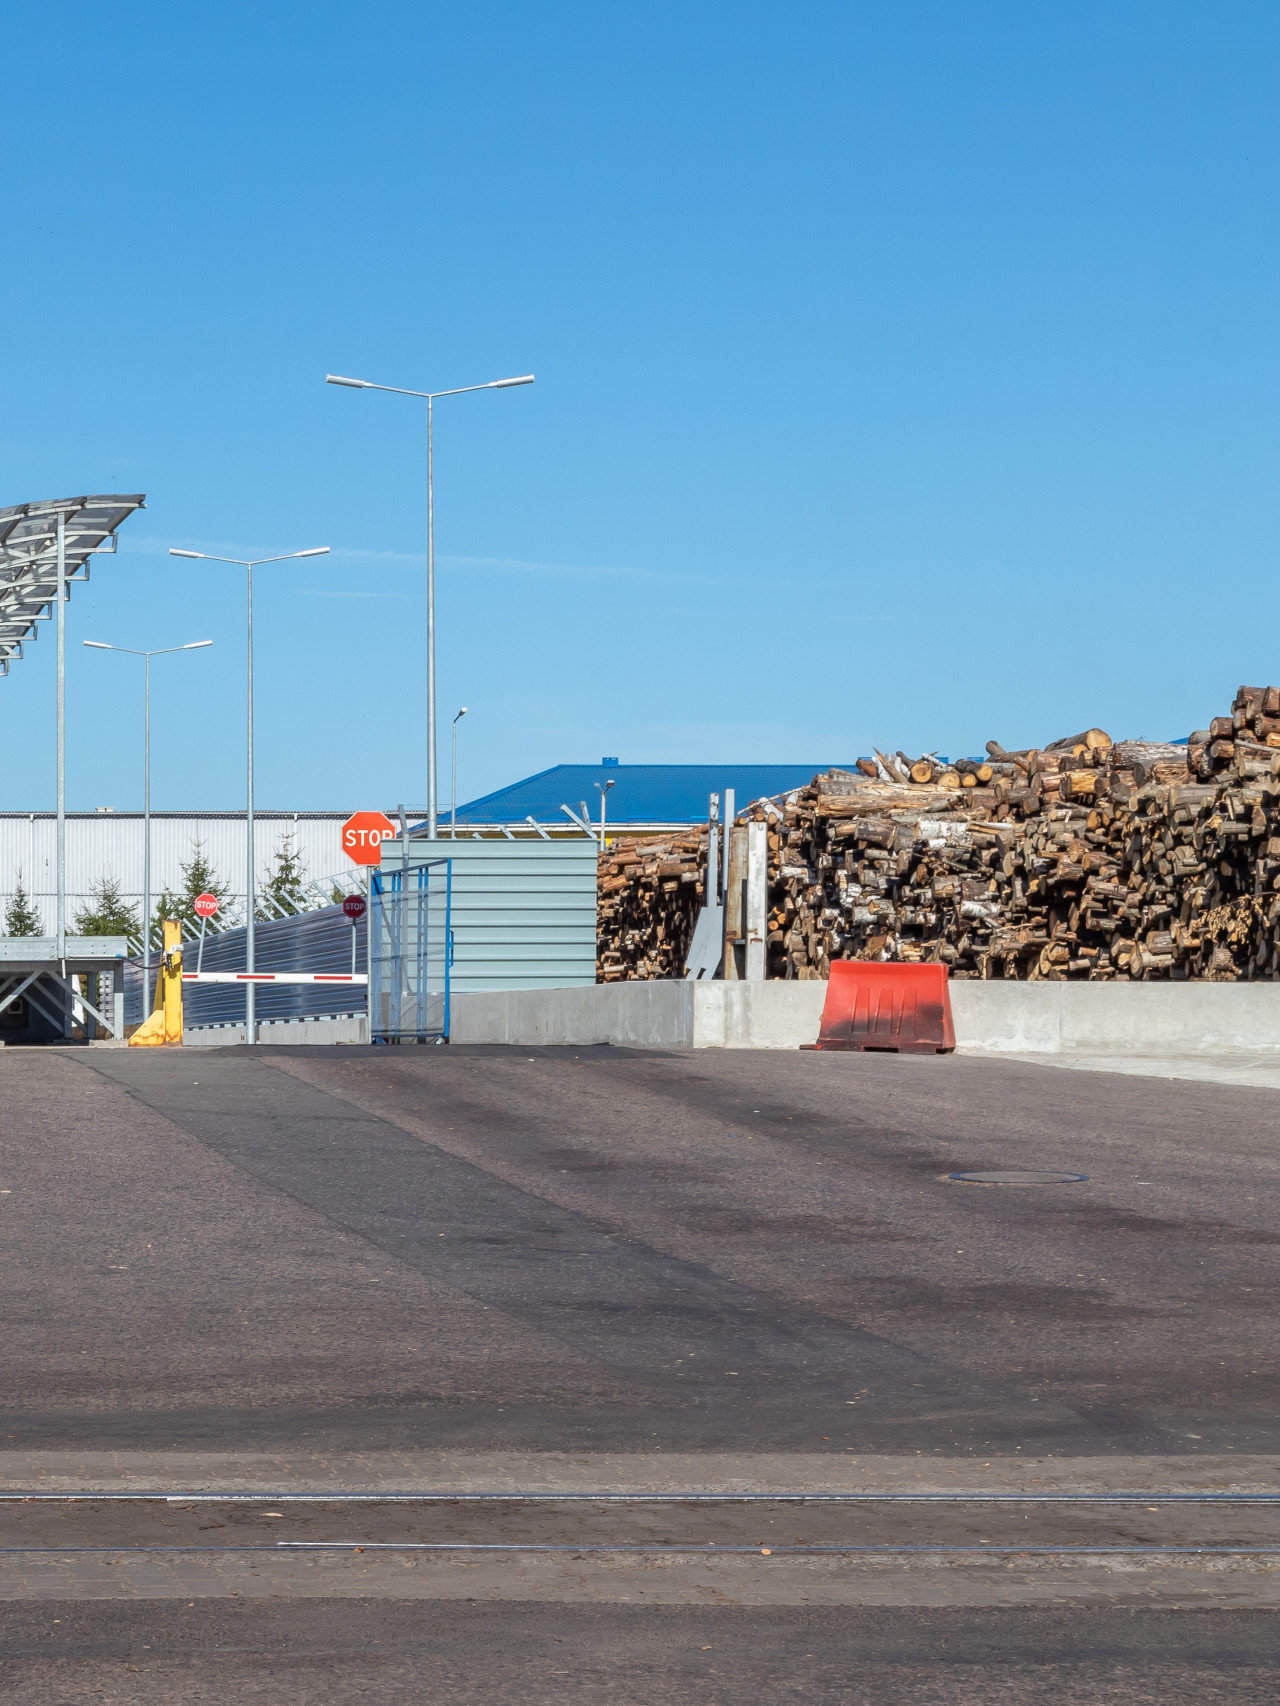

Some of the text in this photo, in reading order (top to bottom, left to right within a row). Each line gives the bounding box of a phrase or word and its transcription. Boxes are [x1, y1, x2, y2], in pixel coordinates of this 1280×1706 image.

[345, 829, 393, 847] STOP
[196, 900, 216, 909] STOP
[345, 902, 365, 910] STOP
